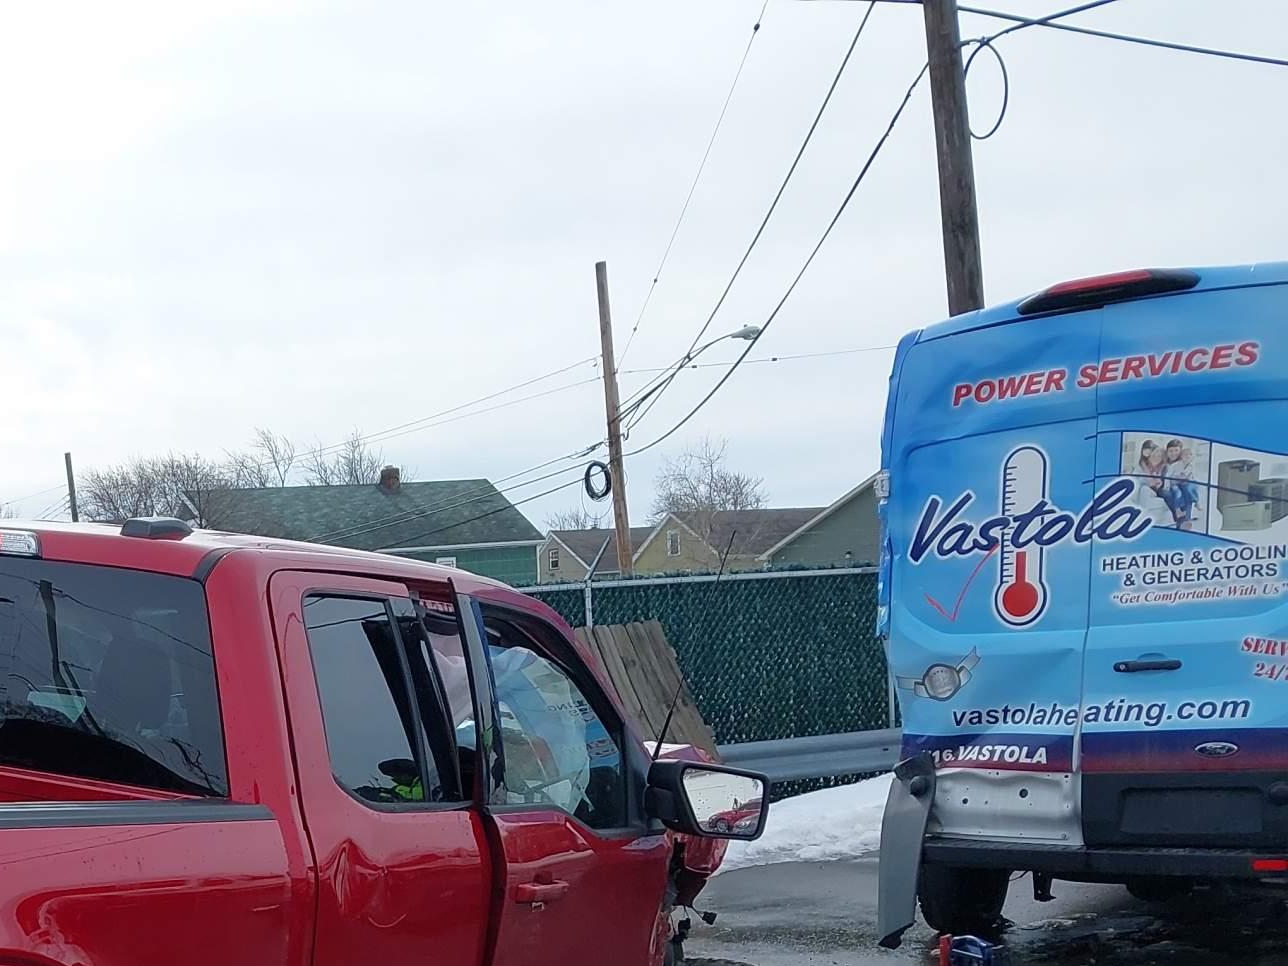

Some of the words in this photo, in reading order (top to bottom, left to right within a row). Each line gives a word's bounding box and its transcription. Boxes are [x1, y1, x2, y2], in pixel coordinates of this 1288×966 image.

[953, 368, 1066, 407] POWER
[1077, 341, 1260, 388] SERVICES
[910, 477, 1153, 563] Vastola
[1102, 552, 1184, 572] HEATING
[1190, 550, 1203, 565] &
[1210, 544, 1287, 562] COOLIN
[1123, 573, 1136, 587] &
[1142, 562, 1278, 585] GENERATORS
[1144, 587, 1224, 603] Comfortable
[1228, 584, 1257, 596] With
[952, 698, 1251, 727] vastolaheating.com
[922, 745, 1048, 764] 16.VASTOLA
